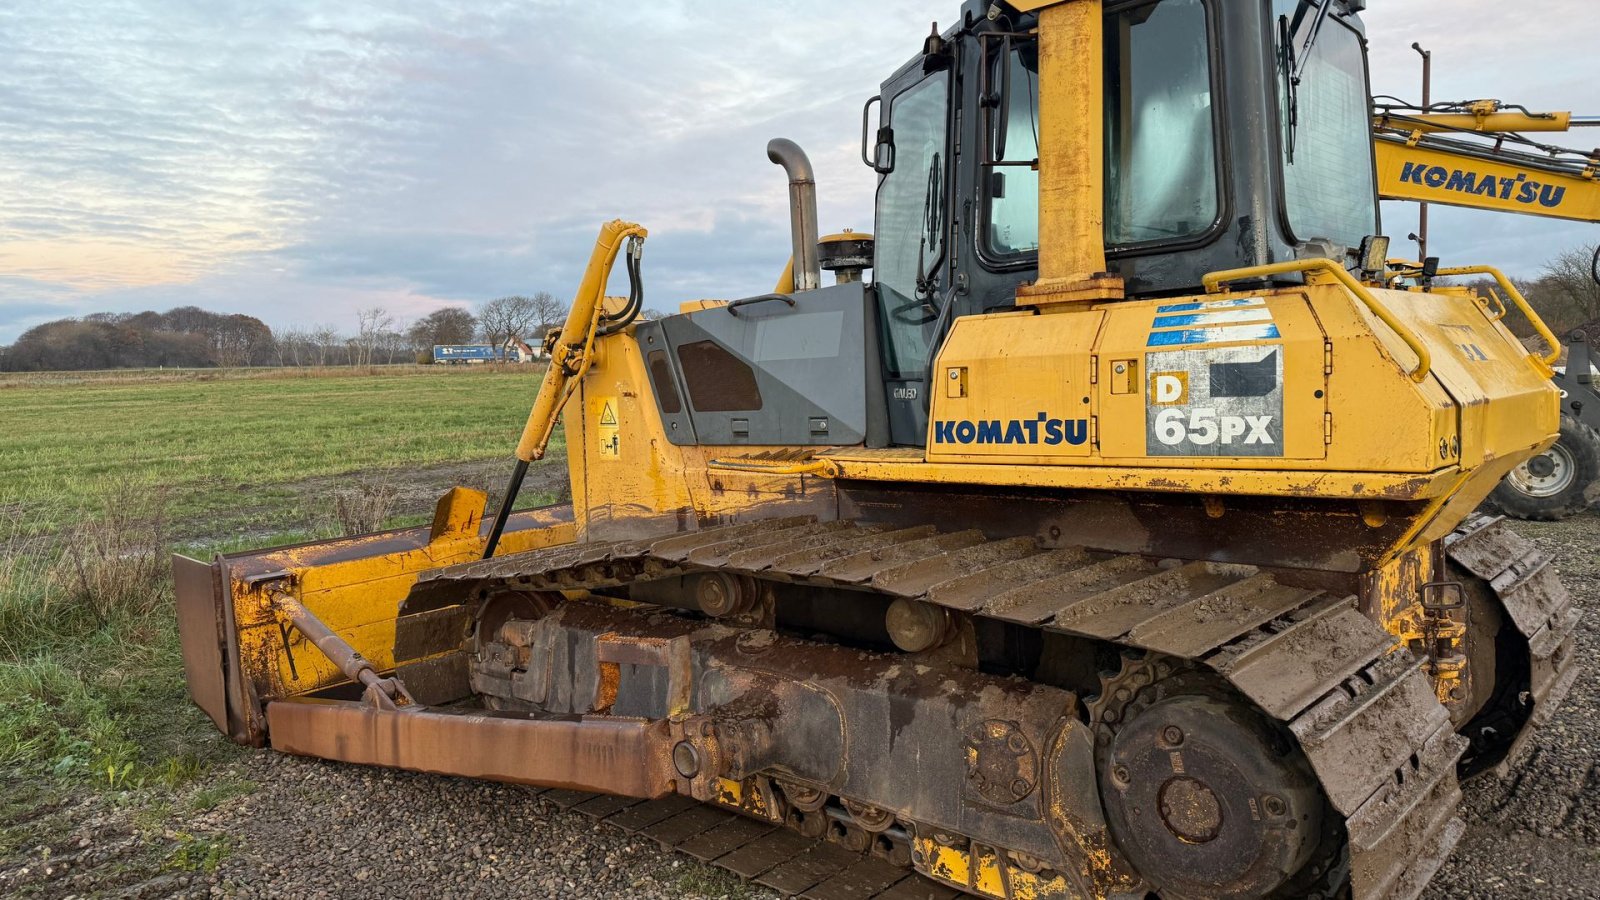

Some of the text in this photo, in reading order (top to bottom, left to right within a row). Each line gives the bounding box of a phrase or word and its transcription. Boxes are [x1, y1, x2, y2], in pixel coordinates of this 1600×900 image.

[1400, 161, 1566, 208] KOMATSU
[1156, 375, 1183, 403] D
[935, 411, 1088, 445] KOMATSU
[1154, 407, 1275, 446] 65PX
